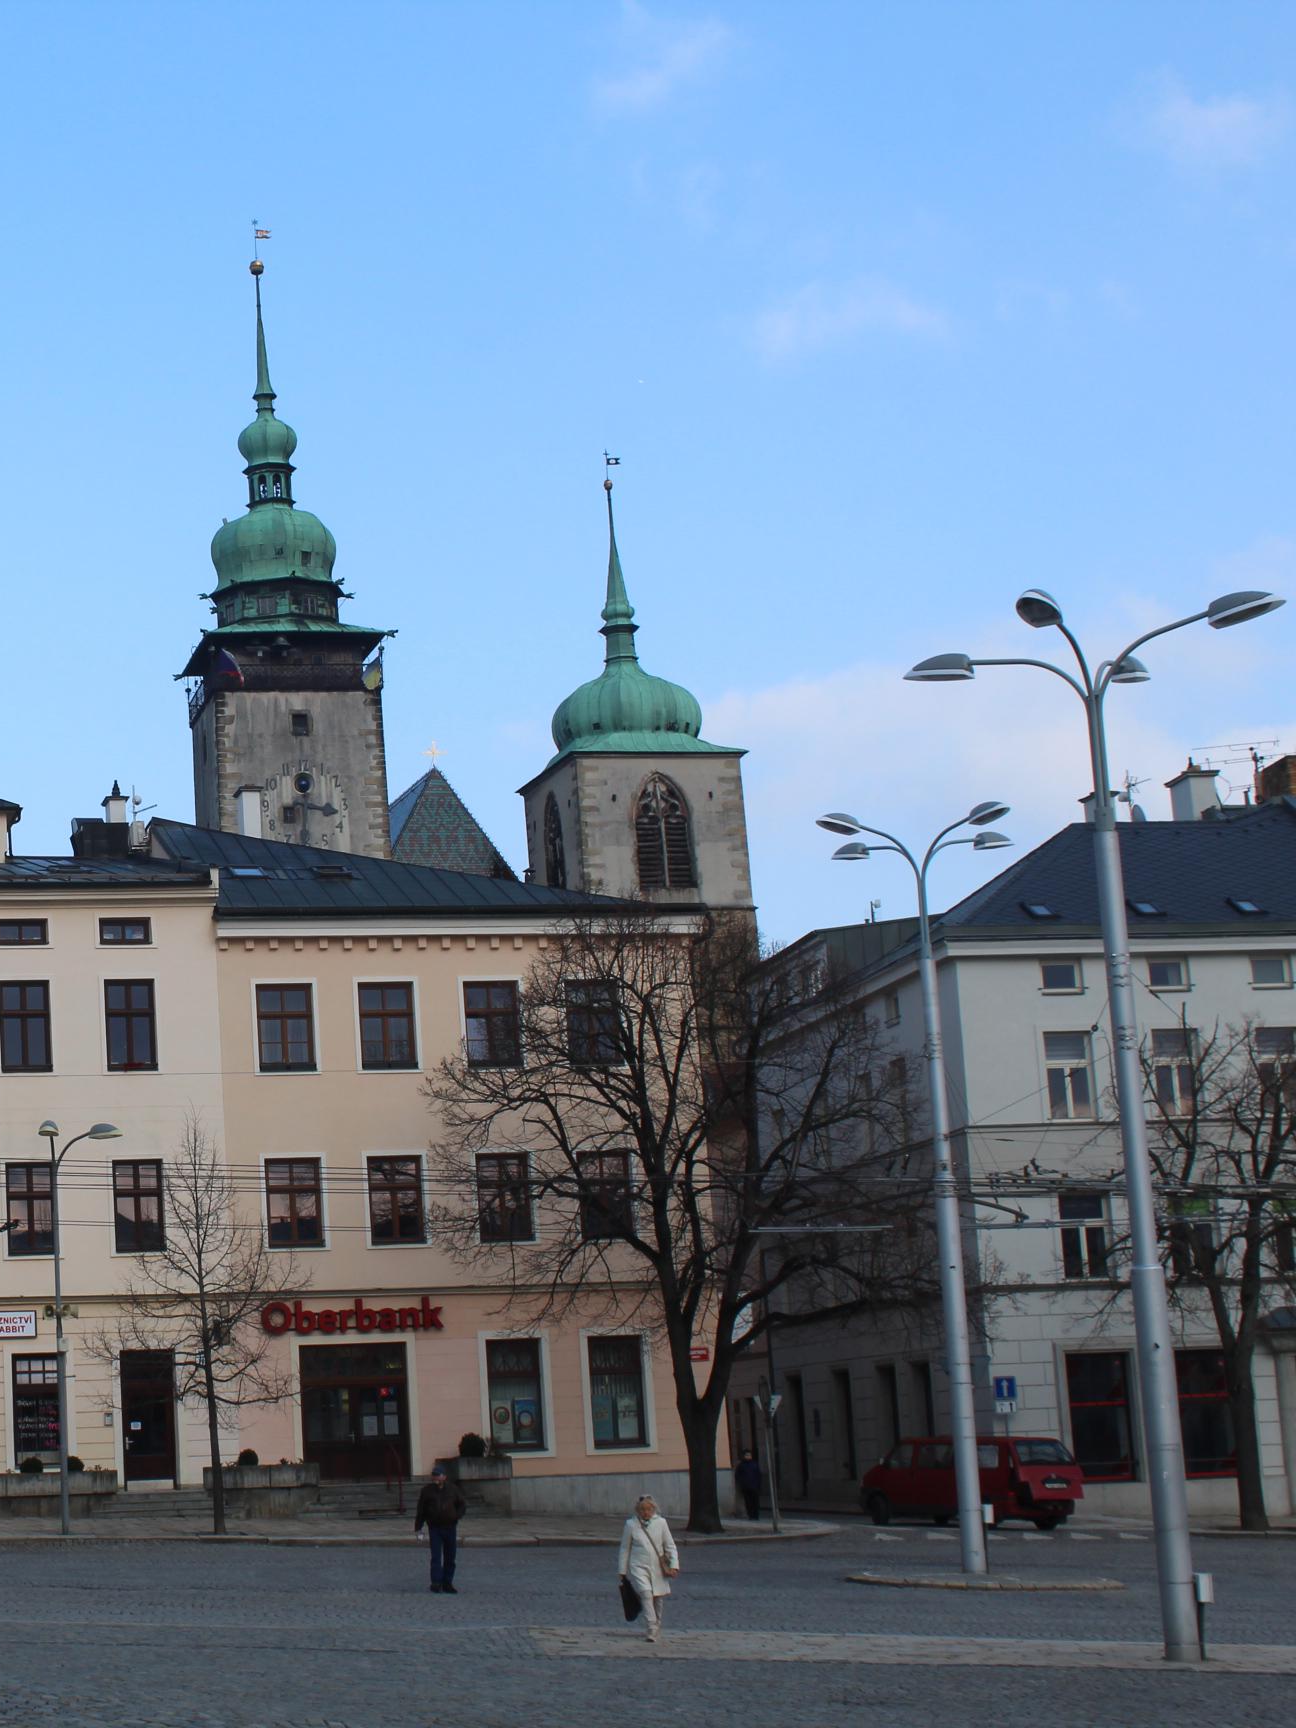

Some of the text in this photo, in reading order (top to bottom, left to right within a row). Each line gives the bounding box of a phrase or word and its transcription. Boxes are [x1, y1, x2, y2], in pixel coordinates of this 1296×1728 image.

[265, 778, 277, 791] 10
[262, 800, 270, 812] 9
[341, 798, 349, 812] 3
[269, 819, 276, 831] 8
[334, 820, 344, 833] 4
[321, 834, 329, 846] 5
[261, 1295, 445, 1337] Oberbank
